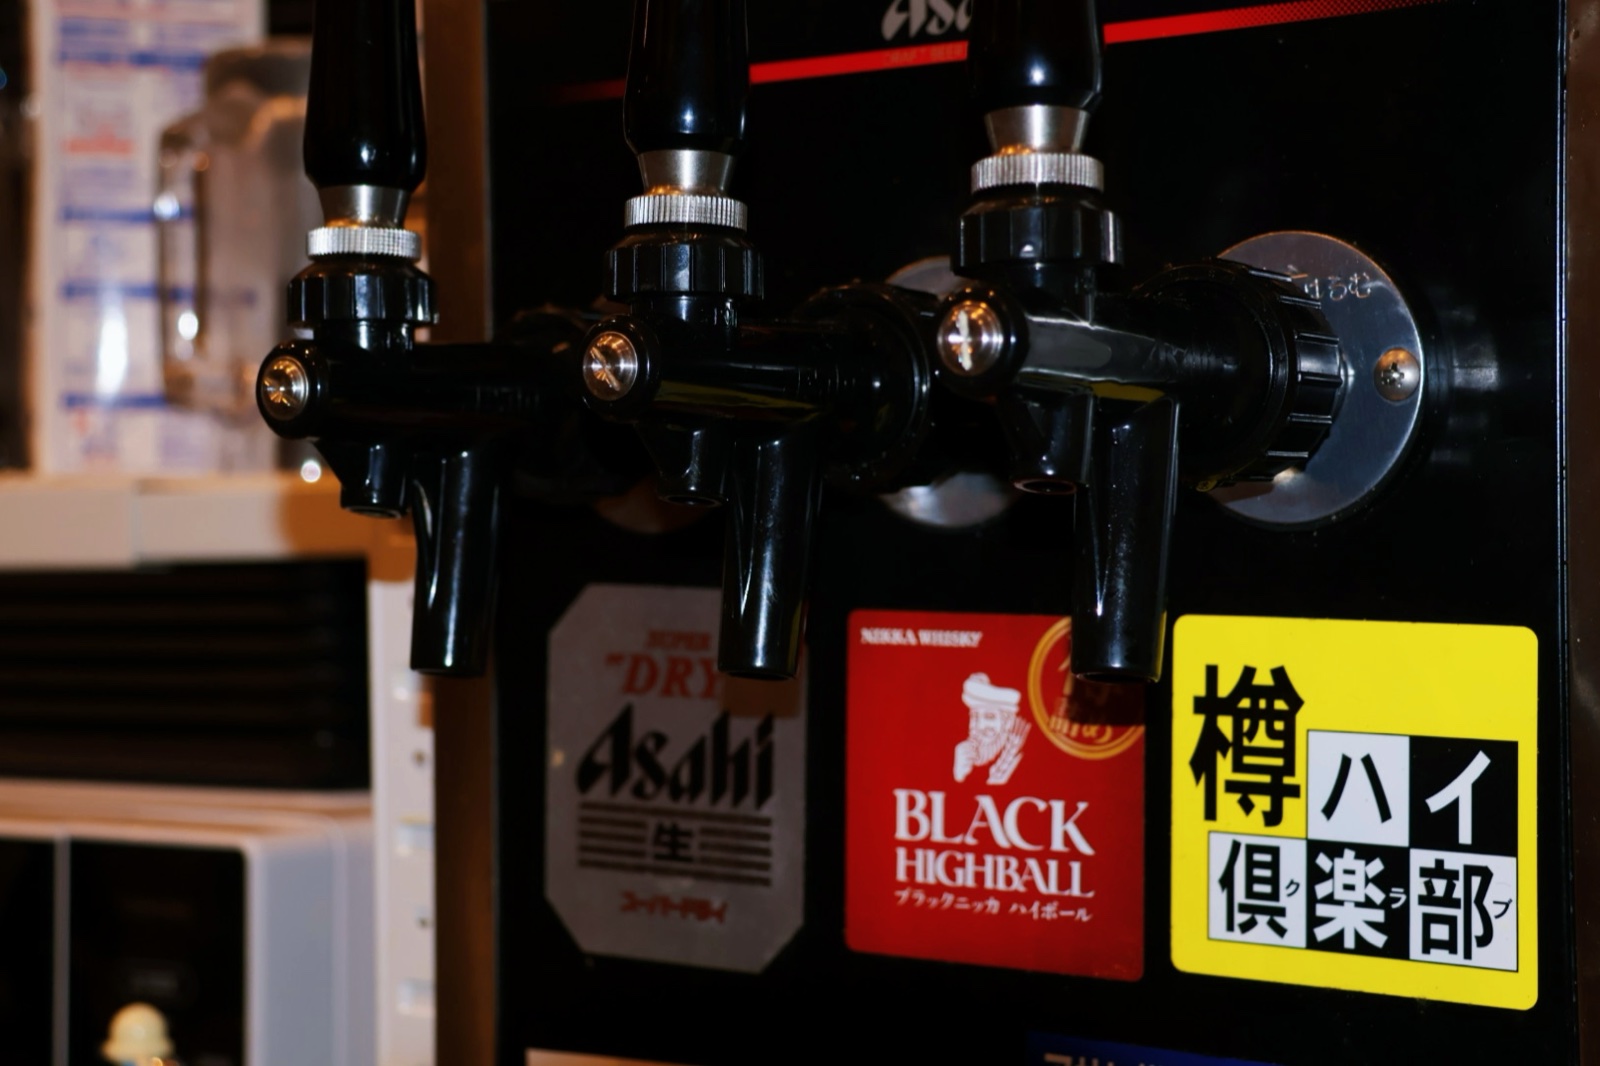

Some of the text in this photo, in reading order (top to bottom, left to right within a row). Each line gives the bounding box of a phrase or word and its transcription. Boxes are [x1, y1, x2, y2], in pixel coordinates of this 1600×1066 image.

[575, 703, 775, 811] Asahi
[653, 822, 695, 863] 生
[893, 788, 1096, 856] BLACK
[895, 847, 1095, 898] HIGHBALL
[1218, 838, 1494, 961] 倶楽部
[894, 887, 1093, 923] ブラックニッカ ハイボール
